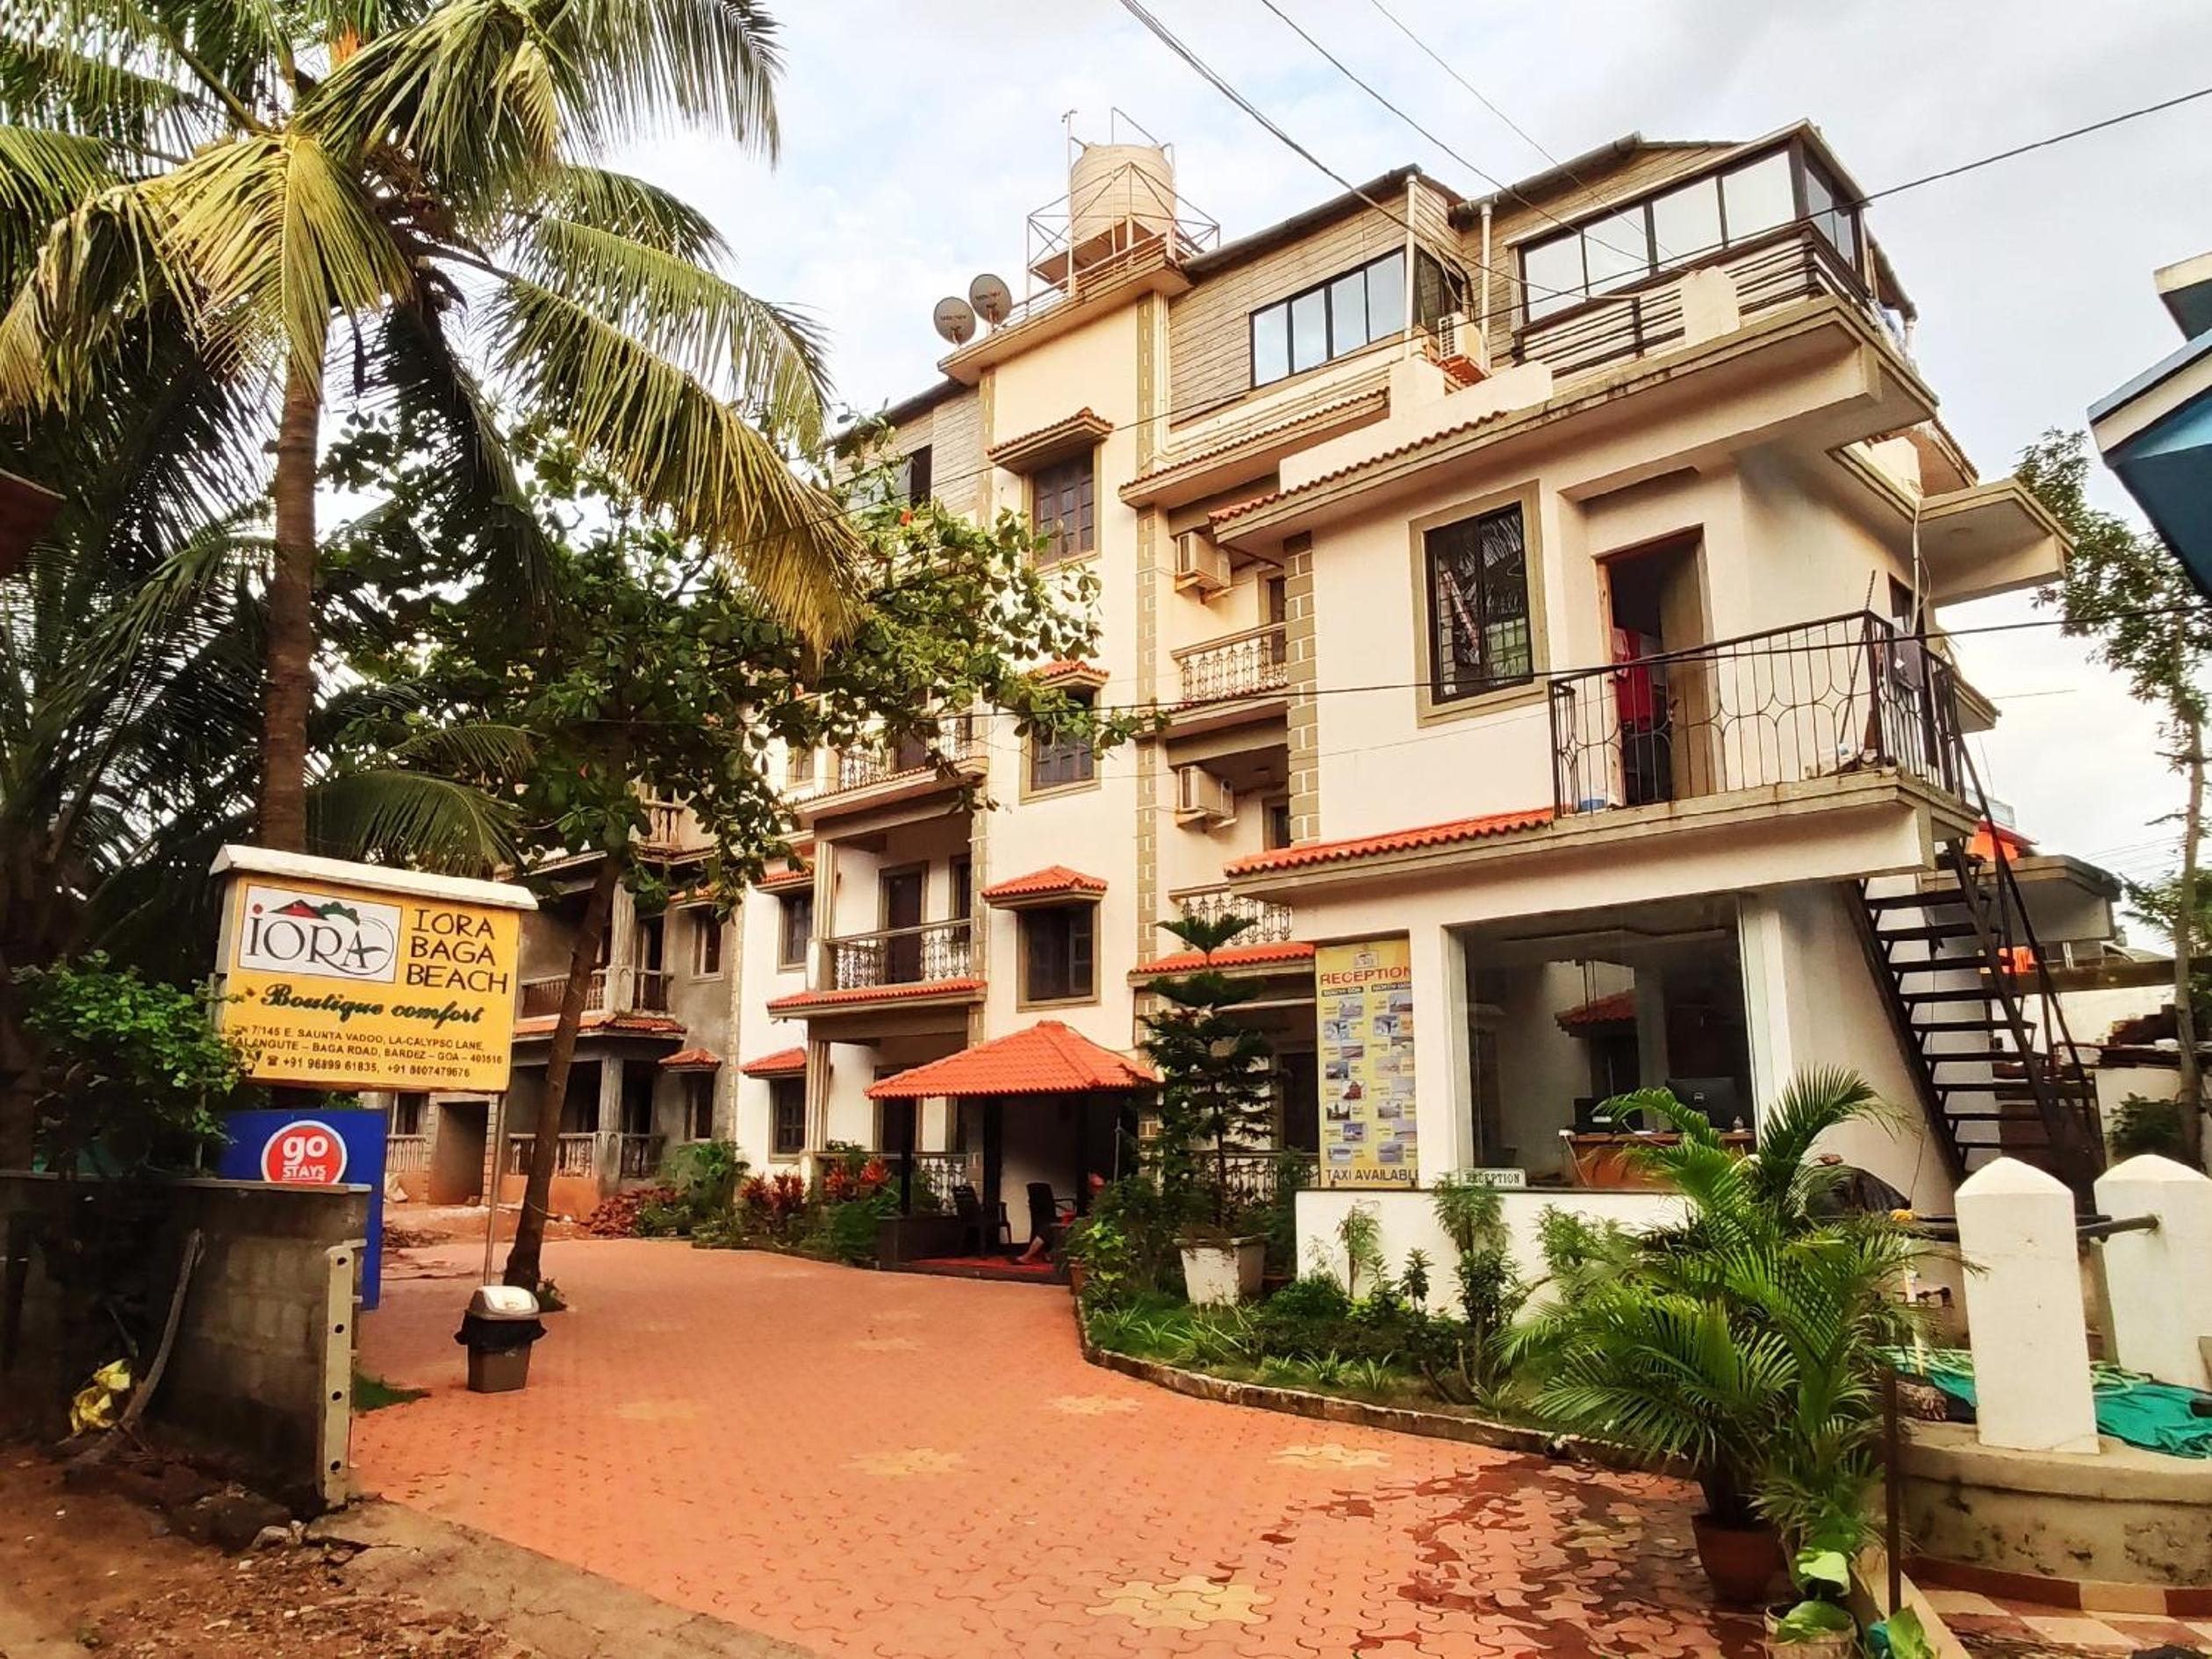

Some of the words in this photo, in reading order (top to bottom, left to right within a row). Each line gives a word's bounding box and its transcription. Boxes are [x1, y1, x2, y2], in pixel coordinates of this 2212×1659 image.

[412, 908, 495, 940] IORA
[410, 935, 497, 966] BAGA
[406, 963, 508, 995] BEACH
[260, 983, 385, 1023] Boutique
[391, 999, 485, 1030] comfort
[297, 1028, 343, 1041] SAUNTA
[388, 1035, 454, 1051] LA-CALYPSO
[312, 1042, 345, 1054] BAGA
[384, 1047, 427, 1060] BARDEZ
[437, 1052, 460, 1062] GOA
[283, 1056, 304, 1068] +91
[387, 1063, 406, 1074] +91
[283, 1135, 328, 1166] go
[283, 1165, 327, 1178] STAYS
[1325, 1169, 1352, 1181] TAXI
[1354, 1168, 1419, 1181] AVAILABL
